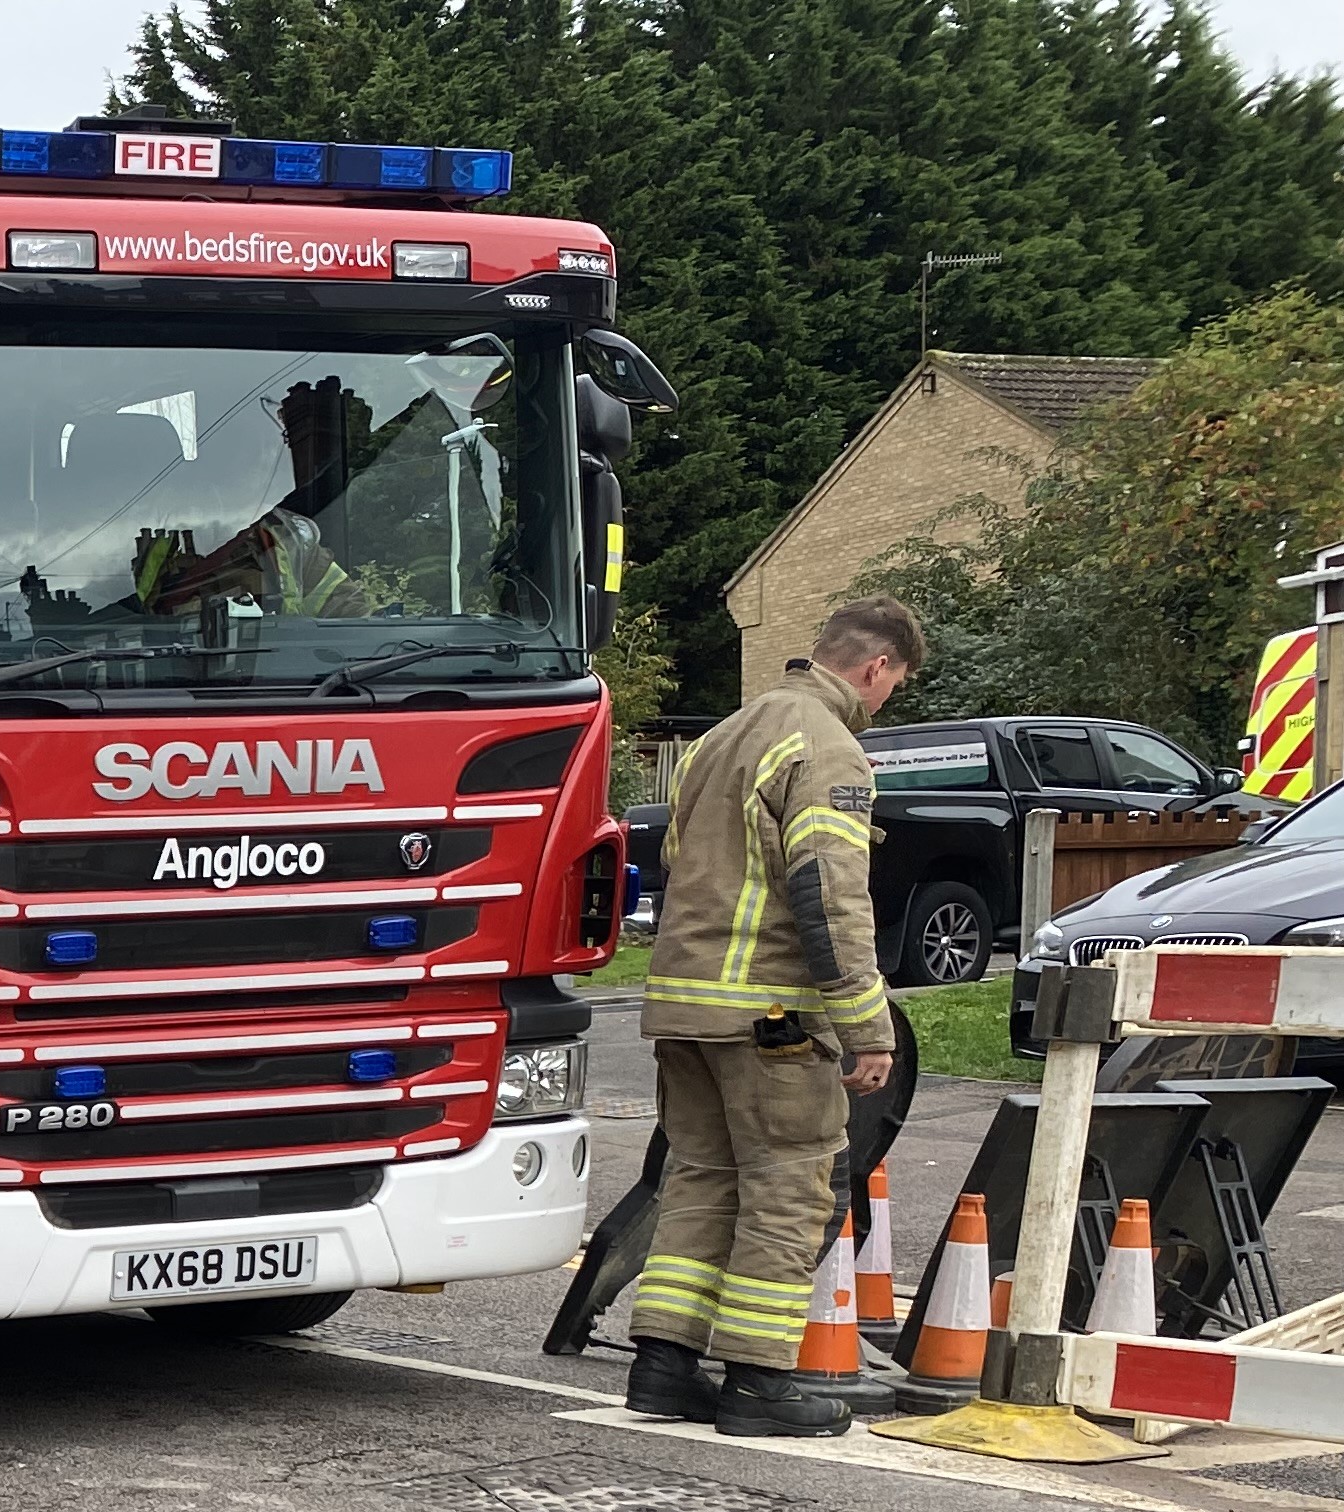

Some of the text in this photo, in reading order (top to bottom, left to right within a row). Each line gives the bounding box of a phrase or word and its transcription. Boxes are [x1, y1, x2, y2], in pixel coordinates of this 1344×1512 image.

[122, 141, 213, 171] FIRE
[105, 230, 387, 273] www.bedsfire.gov.uk
[92, 738, 386, 801] SCANIA
[153, 835, 325, 889] Angloco
[7, 1103, 114, 1133] P 280
[127, 1241, 304, 1292] KX68 DSU
